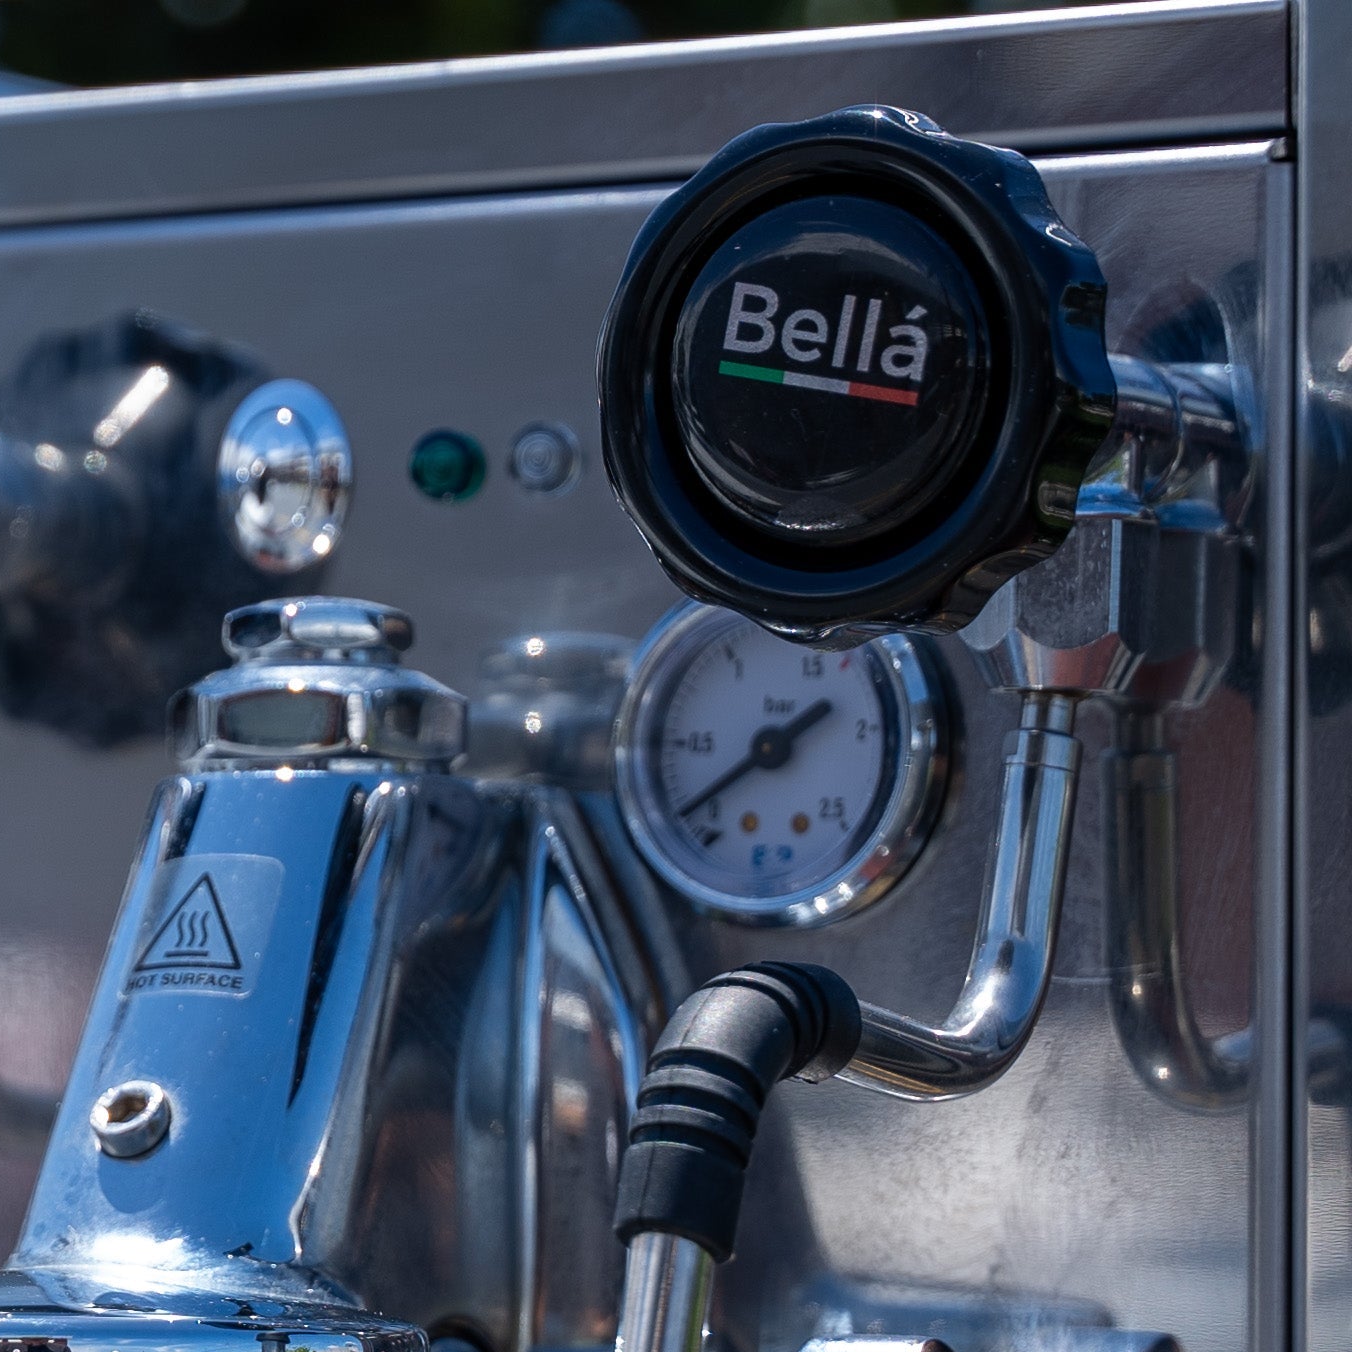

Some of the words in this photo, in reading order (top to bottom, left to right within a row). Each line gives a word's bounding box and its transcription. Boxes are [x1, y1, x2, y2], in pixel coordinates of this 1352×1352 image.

[723, 281, 928, 382] Bellá
[763, 694, 796, 714] bar
[855, 718, 868, 741] 2
[125, 972, 157, 992] HOT
[160, 972, 245, 990] SURFACE
